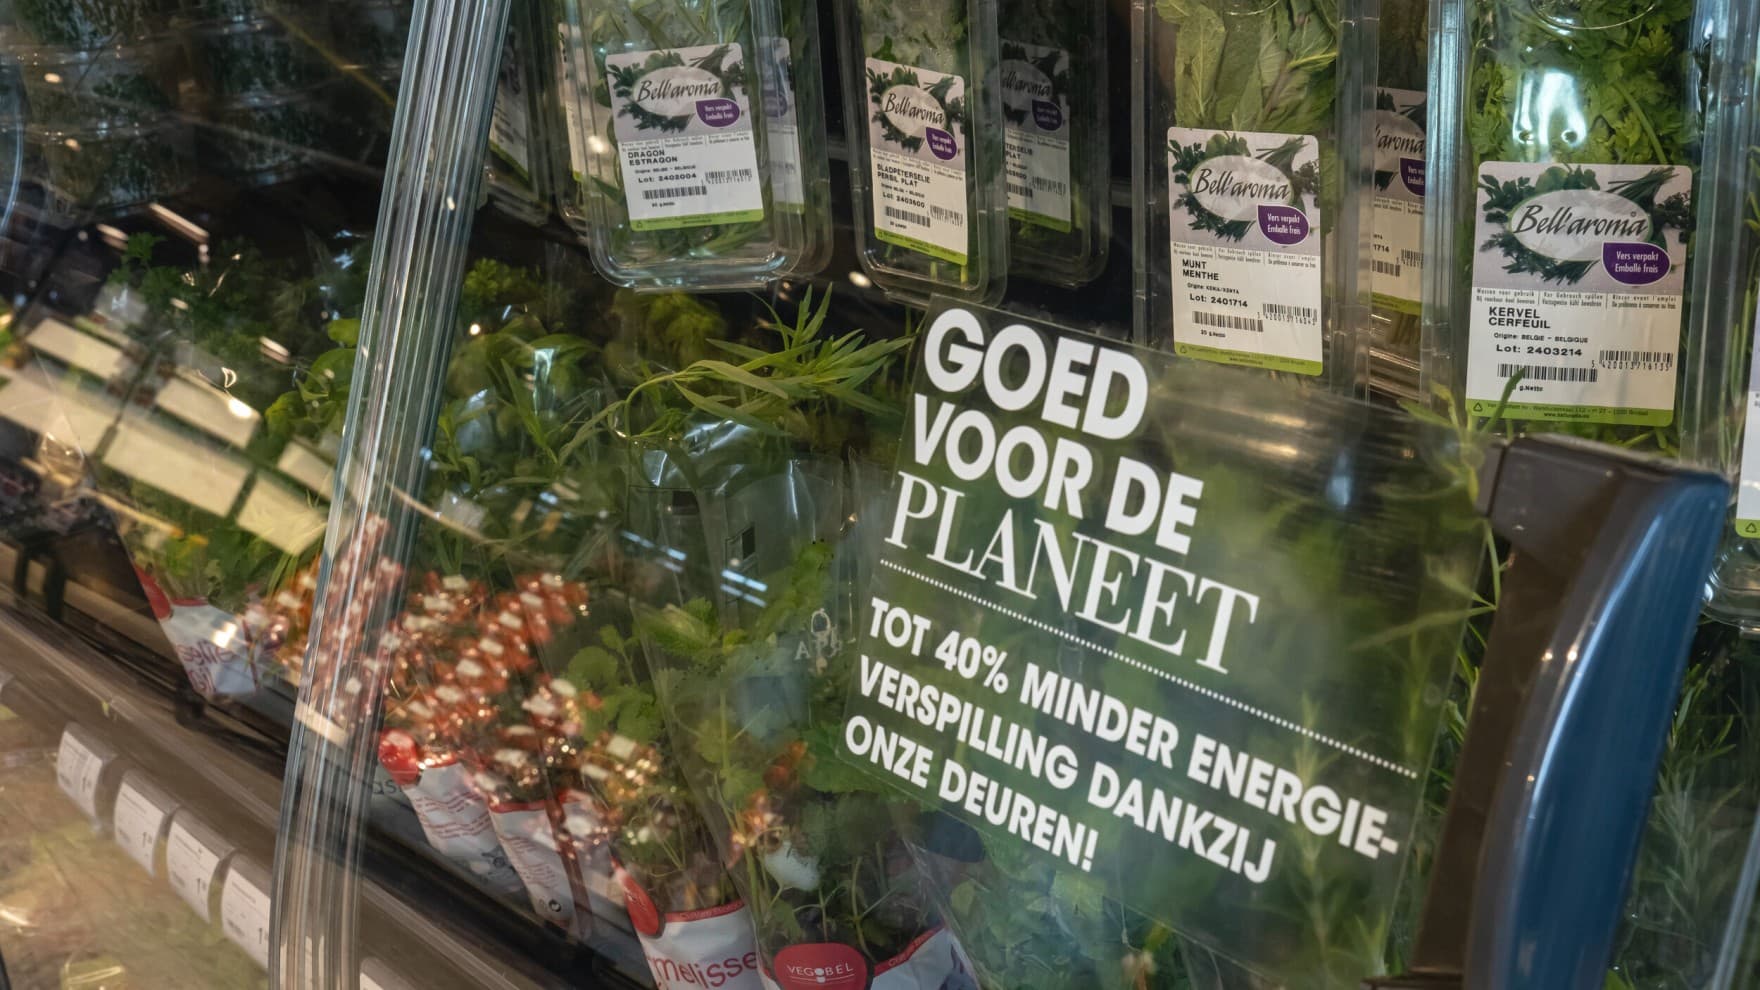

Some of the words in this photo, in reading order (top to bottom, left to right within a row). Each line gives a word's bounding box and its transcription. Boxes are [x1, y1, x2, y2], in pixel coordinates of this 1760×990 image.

[637, 79, 720, 102] Bell'aroma
[884, 92, 945, 124] Bell'aroma
[628, 150, 665, 159] DRAGON
[629, 156, 678, 166] ESTRAGON
[1193, 168, 1290, 200] Bell'aroma
[1512, 204, 1648, 237] Bell'aroma
[1182, 259, 1207, 270] MUNT
[1616, 251, 1631, 260] Vers
[1632, 251, 1660, 263] verpakt
[1182, 269, 1220, 281] MENTHE
[1615, 263, 1642, 274] Emballé
[1643, 264, 1659, 274] frais
[1189, 293, 1207, 303] Lot:
[1211, 296, 1249, 308] 2401714
[1489, 306, 1541, 319] KERVEL
[1488, 317, 1551, 329] CERFEUIL
[1521, 334, 1545, 342] BELGIE
[1554, 336, 1589, 344] BELGIQUE
[1496, 344, 1520, 353] Lot:
[1526, 346, 1583, 357] 2403214
[924, 308, 1149, 440] GOED
[914, 393, 1094, 519] VOOR
[1105, 456, 1205, 556] DE
[884, 471, 1260, 675] PLANEET
[870, 597, 931, 657] TOT
[935, 631, 1009, 694] 40%
[1020, 662, 1180, 769] MINDER
[1187, 733, 1399, 860] ENERGIE-
[859, 654, 1080, 791] VERSPILLING
[1087, 761, 1277, 885] DANKZIJ
[845, 715, 934, 788] ONZE
[939, 759, 1099, 873] DEUREN!
[786, 962, 854, 979] VEGOBEL
